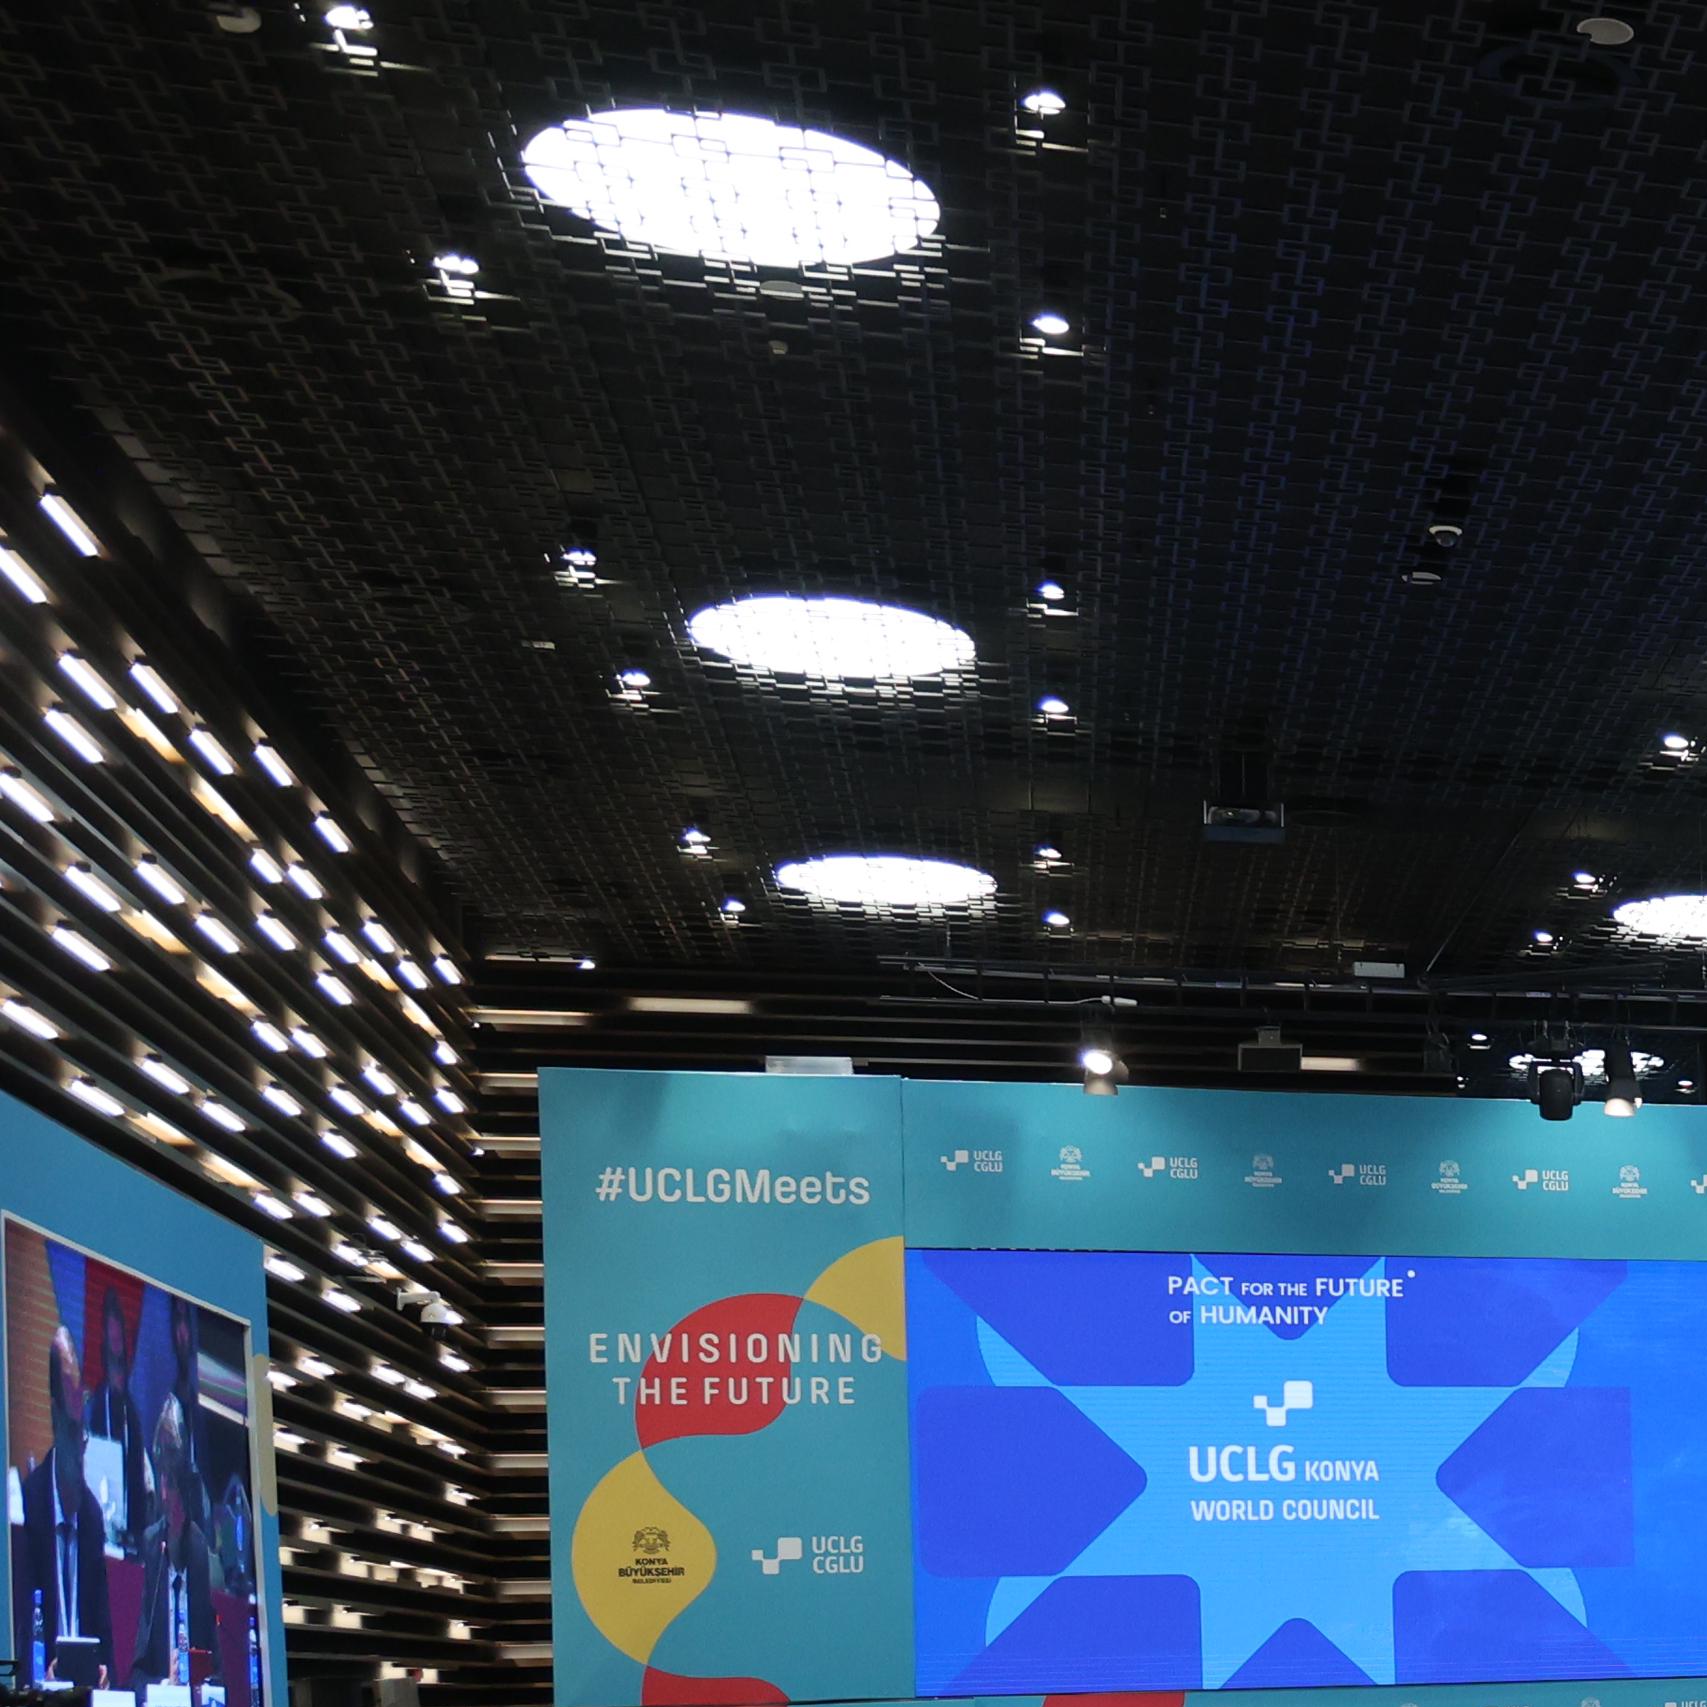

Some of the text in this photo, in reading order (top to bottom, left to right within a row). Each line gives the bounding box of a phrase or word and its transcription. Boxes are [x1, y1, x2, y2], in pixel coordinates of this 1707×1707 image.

[973, 1150, 1004, 1161] UCLG
[1169, 1156, 1198, 1168] UCLG
[973, 1162, 1004, 1173] CGLU
[1169, 1169, 1198, 1180] CGLU
[1359, 1164, 1387, 1175] UCLG
[1359, 1176, 1387, 1186] CGLU
[1541, 1170, 1569, 1180] UCLG
[596, 1167, 869, 1204] #UCLGMeets
[1541, 1181, 1569, 1191] CGLU
[1169, 1276, 1403, 1297] PACT FOR THE FUTURE
[1170, 1306, 1327, 1324] OF HUMANITY
[590, 1333, 882, 1363] ENVISIONING
[613, 1377, 855, 1404] THE FUTURE
[1190, 1445, 1379, 1482] UCLG KONYA
[1191, 1499, 1379, 1521] WORLD COUNCIL
[812, 1536, 863, 1553] UCLG
[635, 1558, 668, 1566] KONYA
[813, 1556, 863, 1573] CGLU
